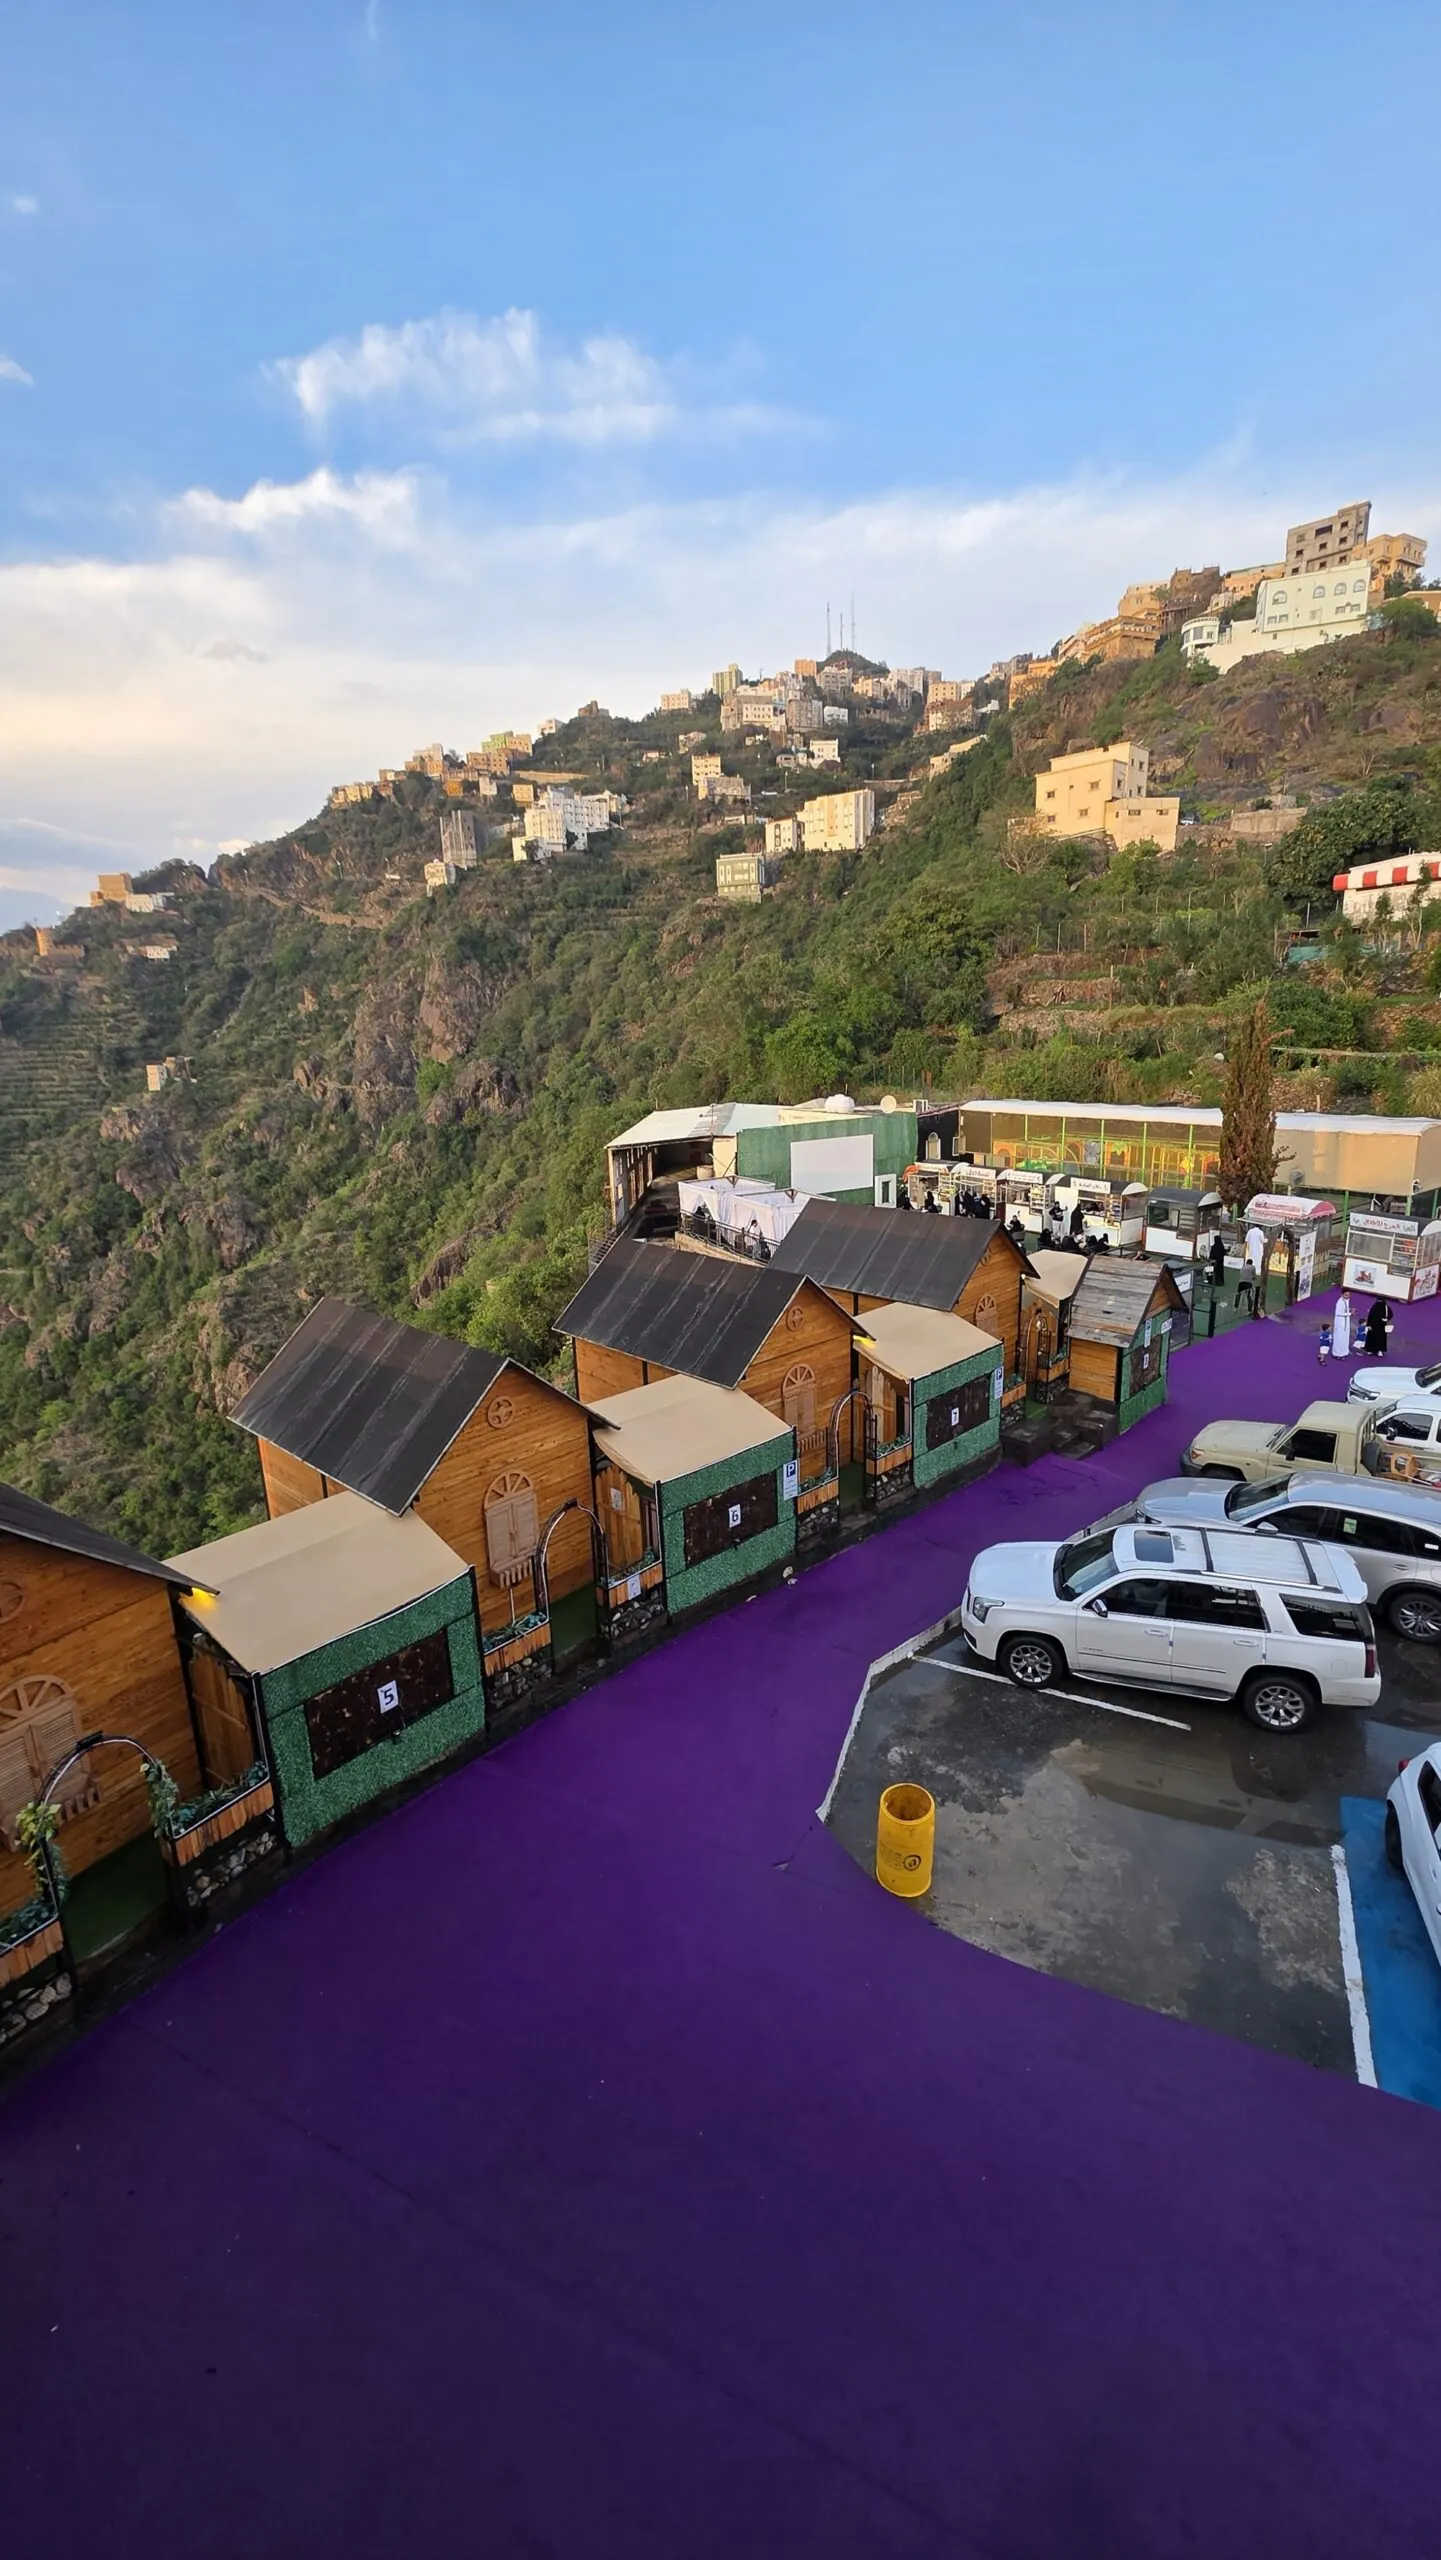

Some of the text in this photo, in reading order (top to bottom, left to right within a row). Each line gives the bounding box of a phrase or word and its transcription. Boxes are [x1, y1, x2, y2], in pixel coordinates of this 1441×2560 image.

[787, 1463, 795, 1477] P
[731, 1510, 739, 1522] 6
[383, 1688, 394, 1706] 5
